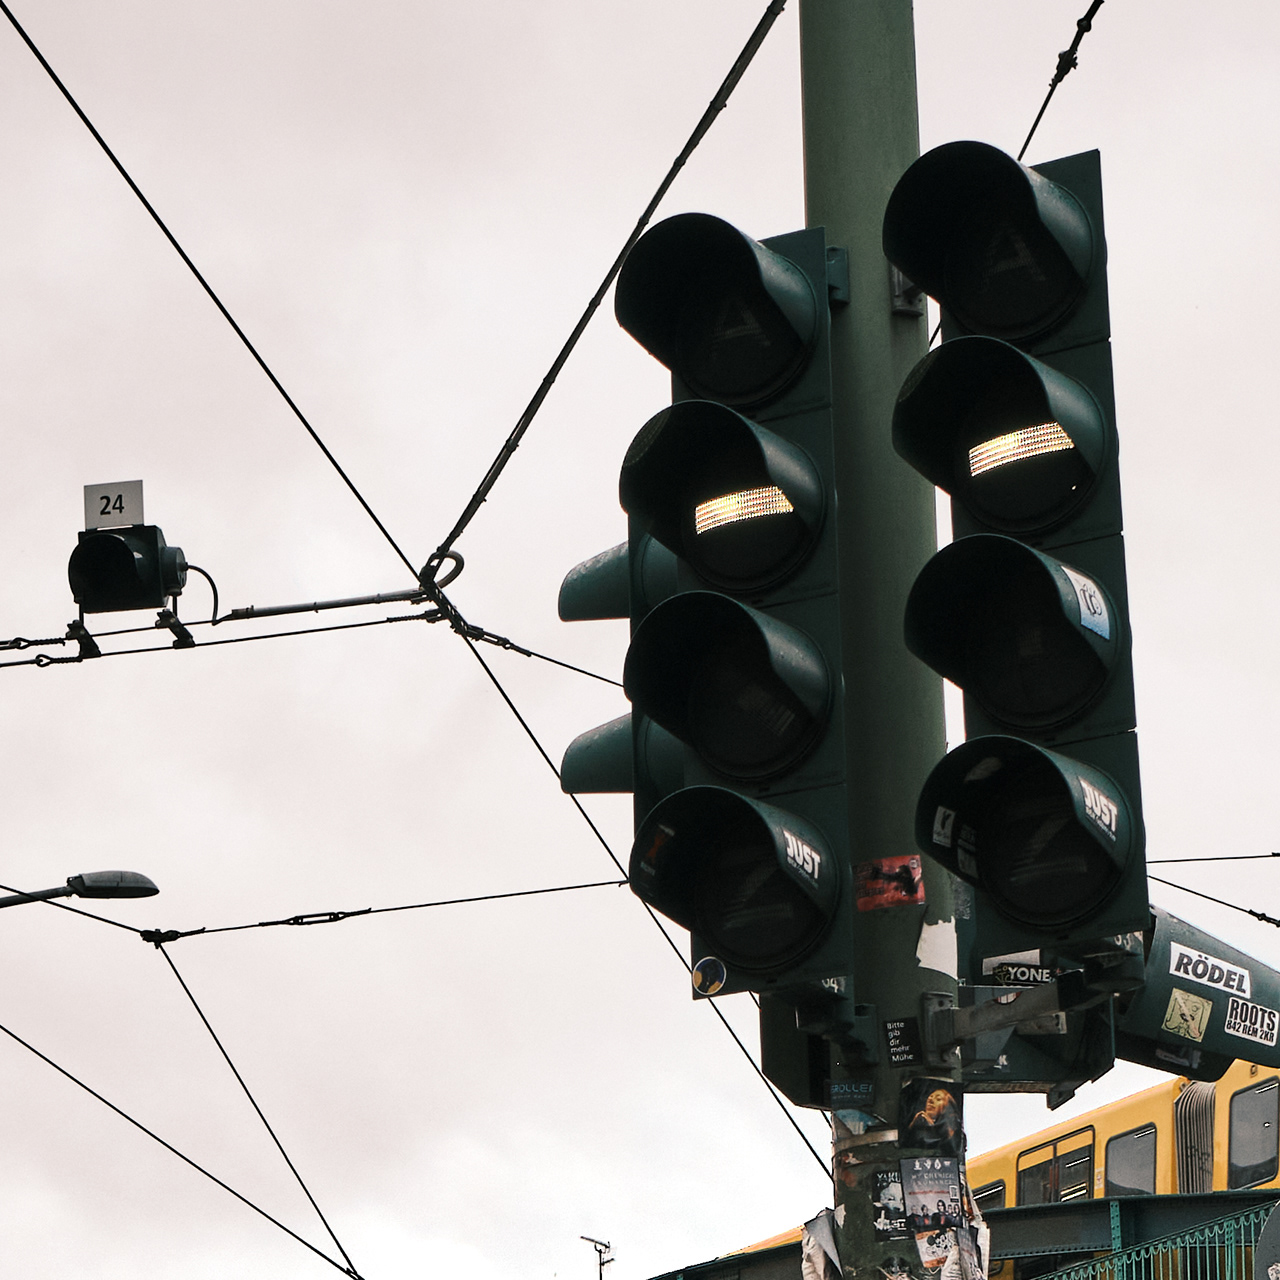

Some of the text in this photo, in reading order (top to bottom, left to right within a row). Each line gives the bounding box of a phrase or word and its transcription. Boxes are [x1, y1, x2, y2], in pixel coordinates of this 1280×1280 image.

[99, 494, 125, 515] 24
[1079, 776, 1118, 833] JUST
[783, 831, 821, 879] JUST
[1008, 966, 1050, 982] YONE
[1174, 953, 1247, 994] RÖDEL
[1229, 998, 1276, 1032] ROOTS
[887, 1021, 905, 1030] Bitte
[888, 1030, 900, 1039] gib
[1226, 1019, 1241, 1033] 842
[1242, 1024, 1258, 1039] REM
[889, 1038, 900, 1046] dir
[890, 1045, 910, 1054] mehr
[892, 1053, 914, 1062] Mühe
